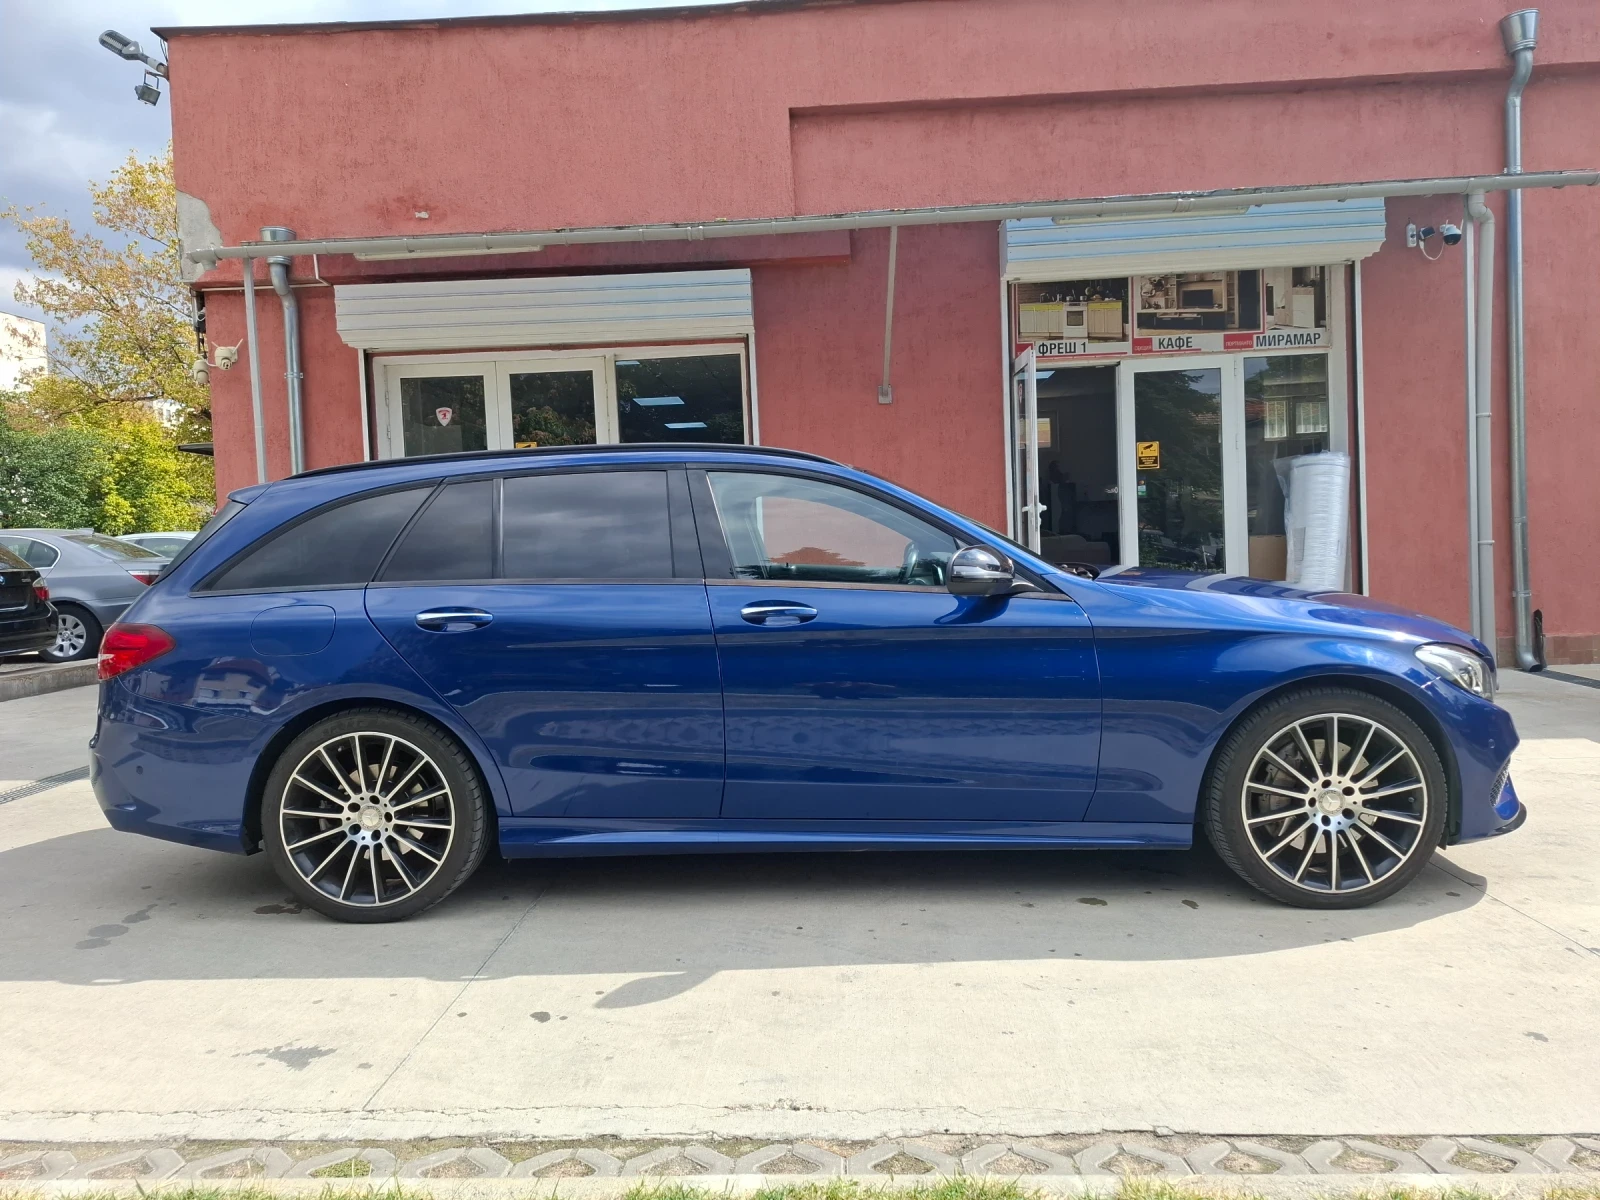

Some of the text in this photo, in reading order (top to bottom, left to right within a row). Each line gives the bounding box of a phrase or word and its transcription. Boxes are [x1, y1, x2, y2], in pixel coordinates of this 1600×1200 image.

[1158, 336, 1193, 350] КАФЕ
[1256, 333, 1321, 347] МИРАМАР
[1038, 341, 1086, 356] ФРЕШ 1
